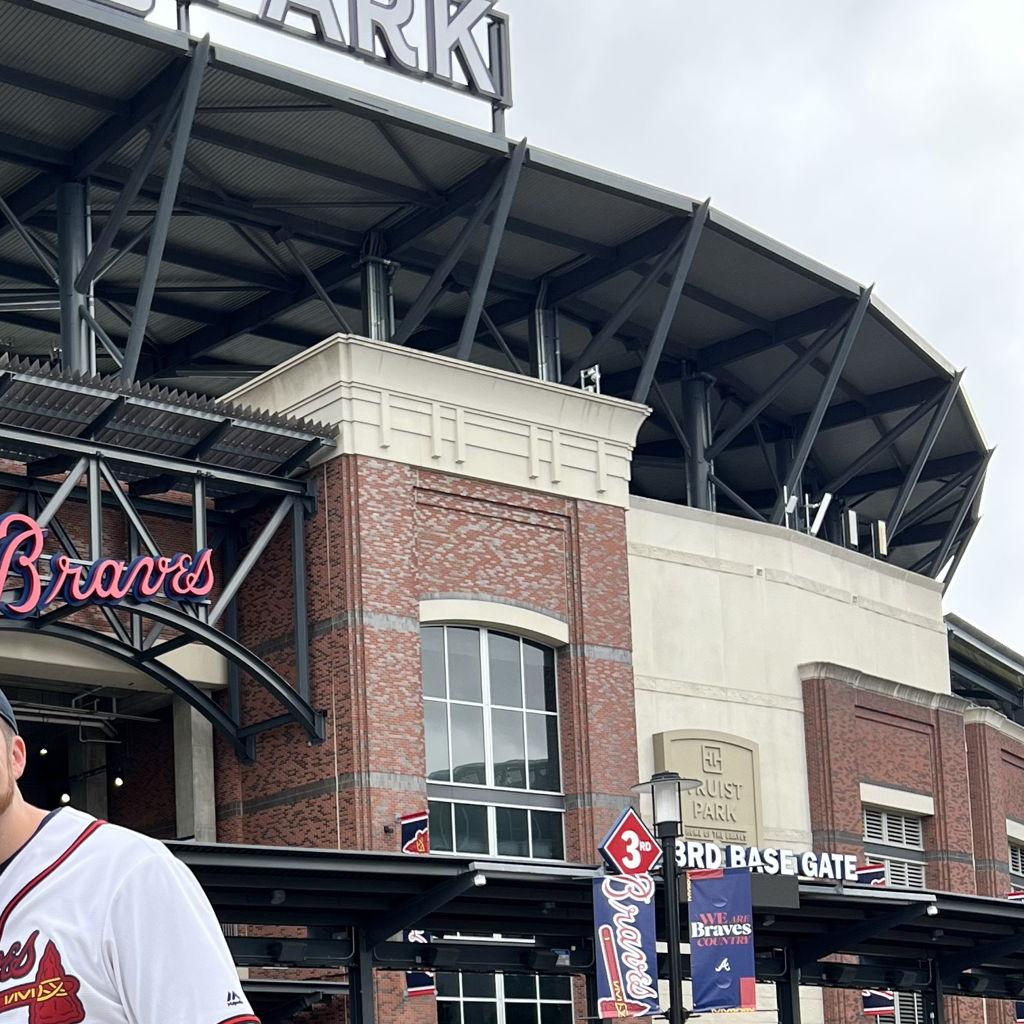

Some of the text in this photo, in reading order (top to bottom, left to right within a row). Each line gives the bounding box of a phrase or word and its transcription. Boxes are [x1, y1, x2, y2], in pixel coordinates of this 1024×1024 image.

[692, 800, 737, 823] PARK
[675, 841, 859, 881] 3RD BASE GATE
[699, 912, 750, 924] WE ARE
[602, 872, 658, 999] Braves
[691, 921, 752, 938] Braves
[697, 936, 750, 947] COUNTRY
